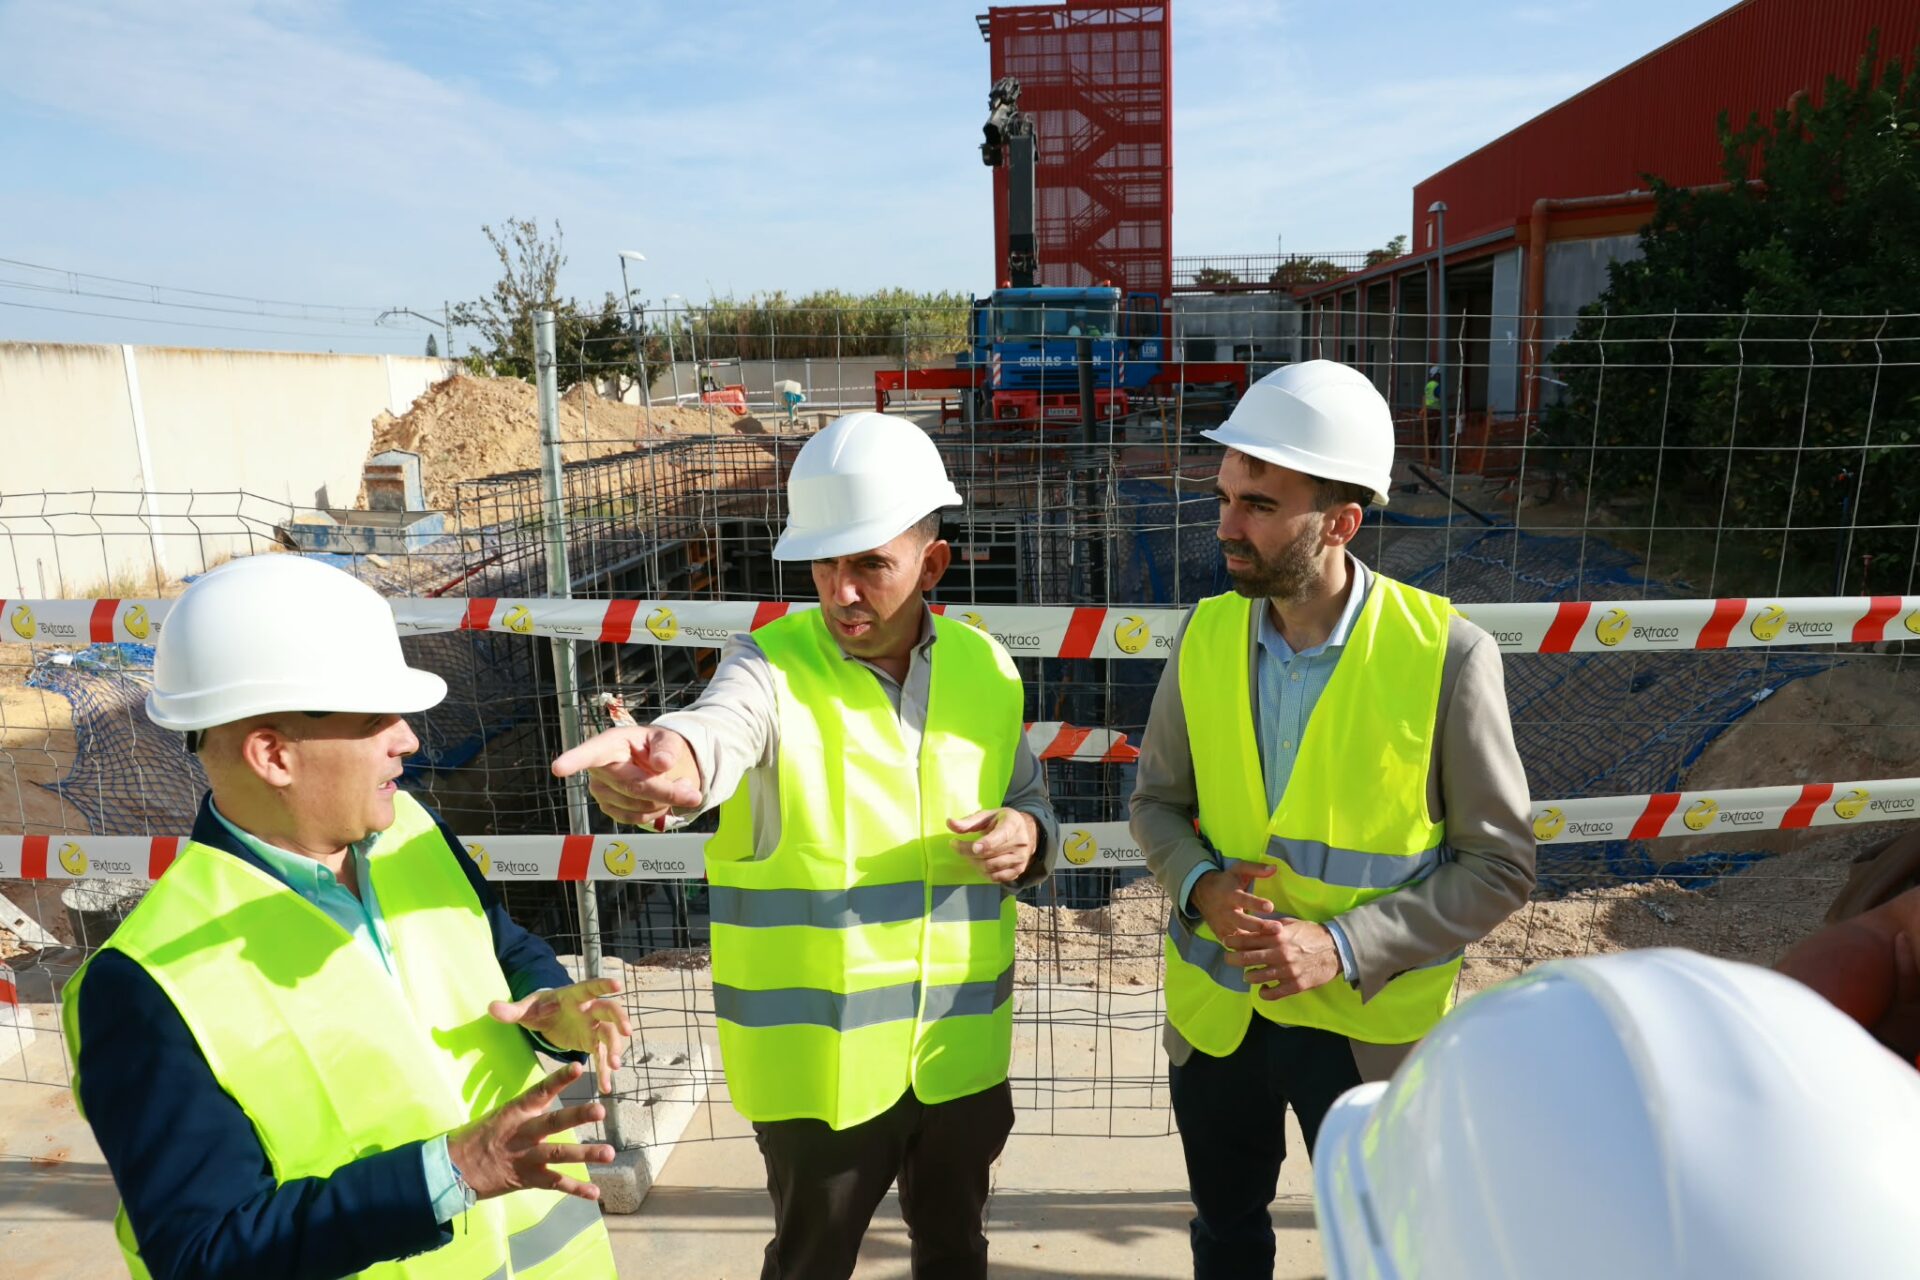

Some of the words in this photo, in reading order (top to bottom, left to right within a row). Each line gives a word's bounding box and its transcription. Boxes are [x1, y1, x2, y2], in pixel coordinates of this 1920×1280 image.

[1071, 356, 1101, 366] LN
[40, 623, 76, 637] extraco
[683, 627, 728, 640] extraco
[1633, 626, 1679, 642] extraco
[1787, 621, 1833, 637] extraco
[991, 633, 1040, 649] extraco
[1492, 630, 1523, 645] traco
[1870, 798, 1915, 813] extraco
[1720, 811, 1764, 825] extraco
[1568, 822, 1613, 836] extraco
[93, 860, 133, 874] extraco
[497, 860, 541, 875] extraco
[641, 859, 686, 873] extraco
